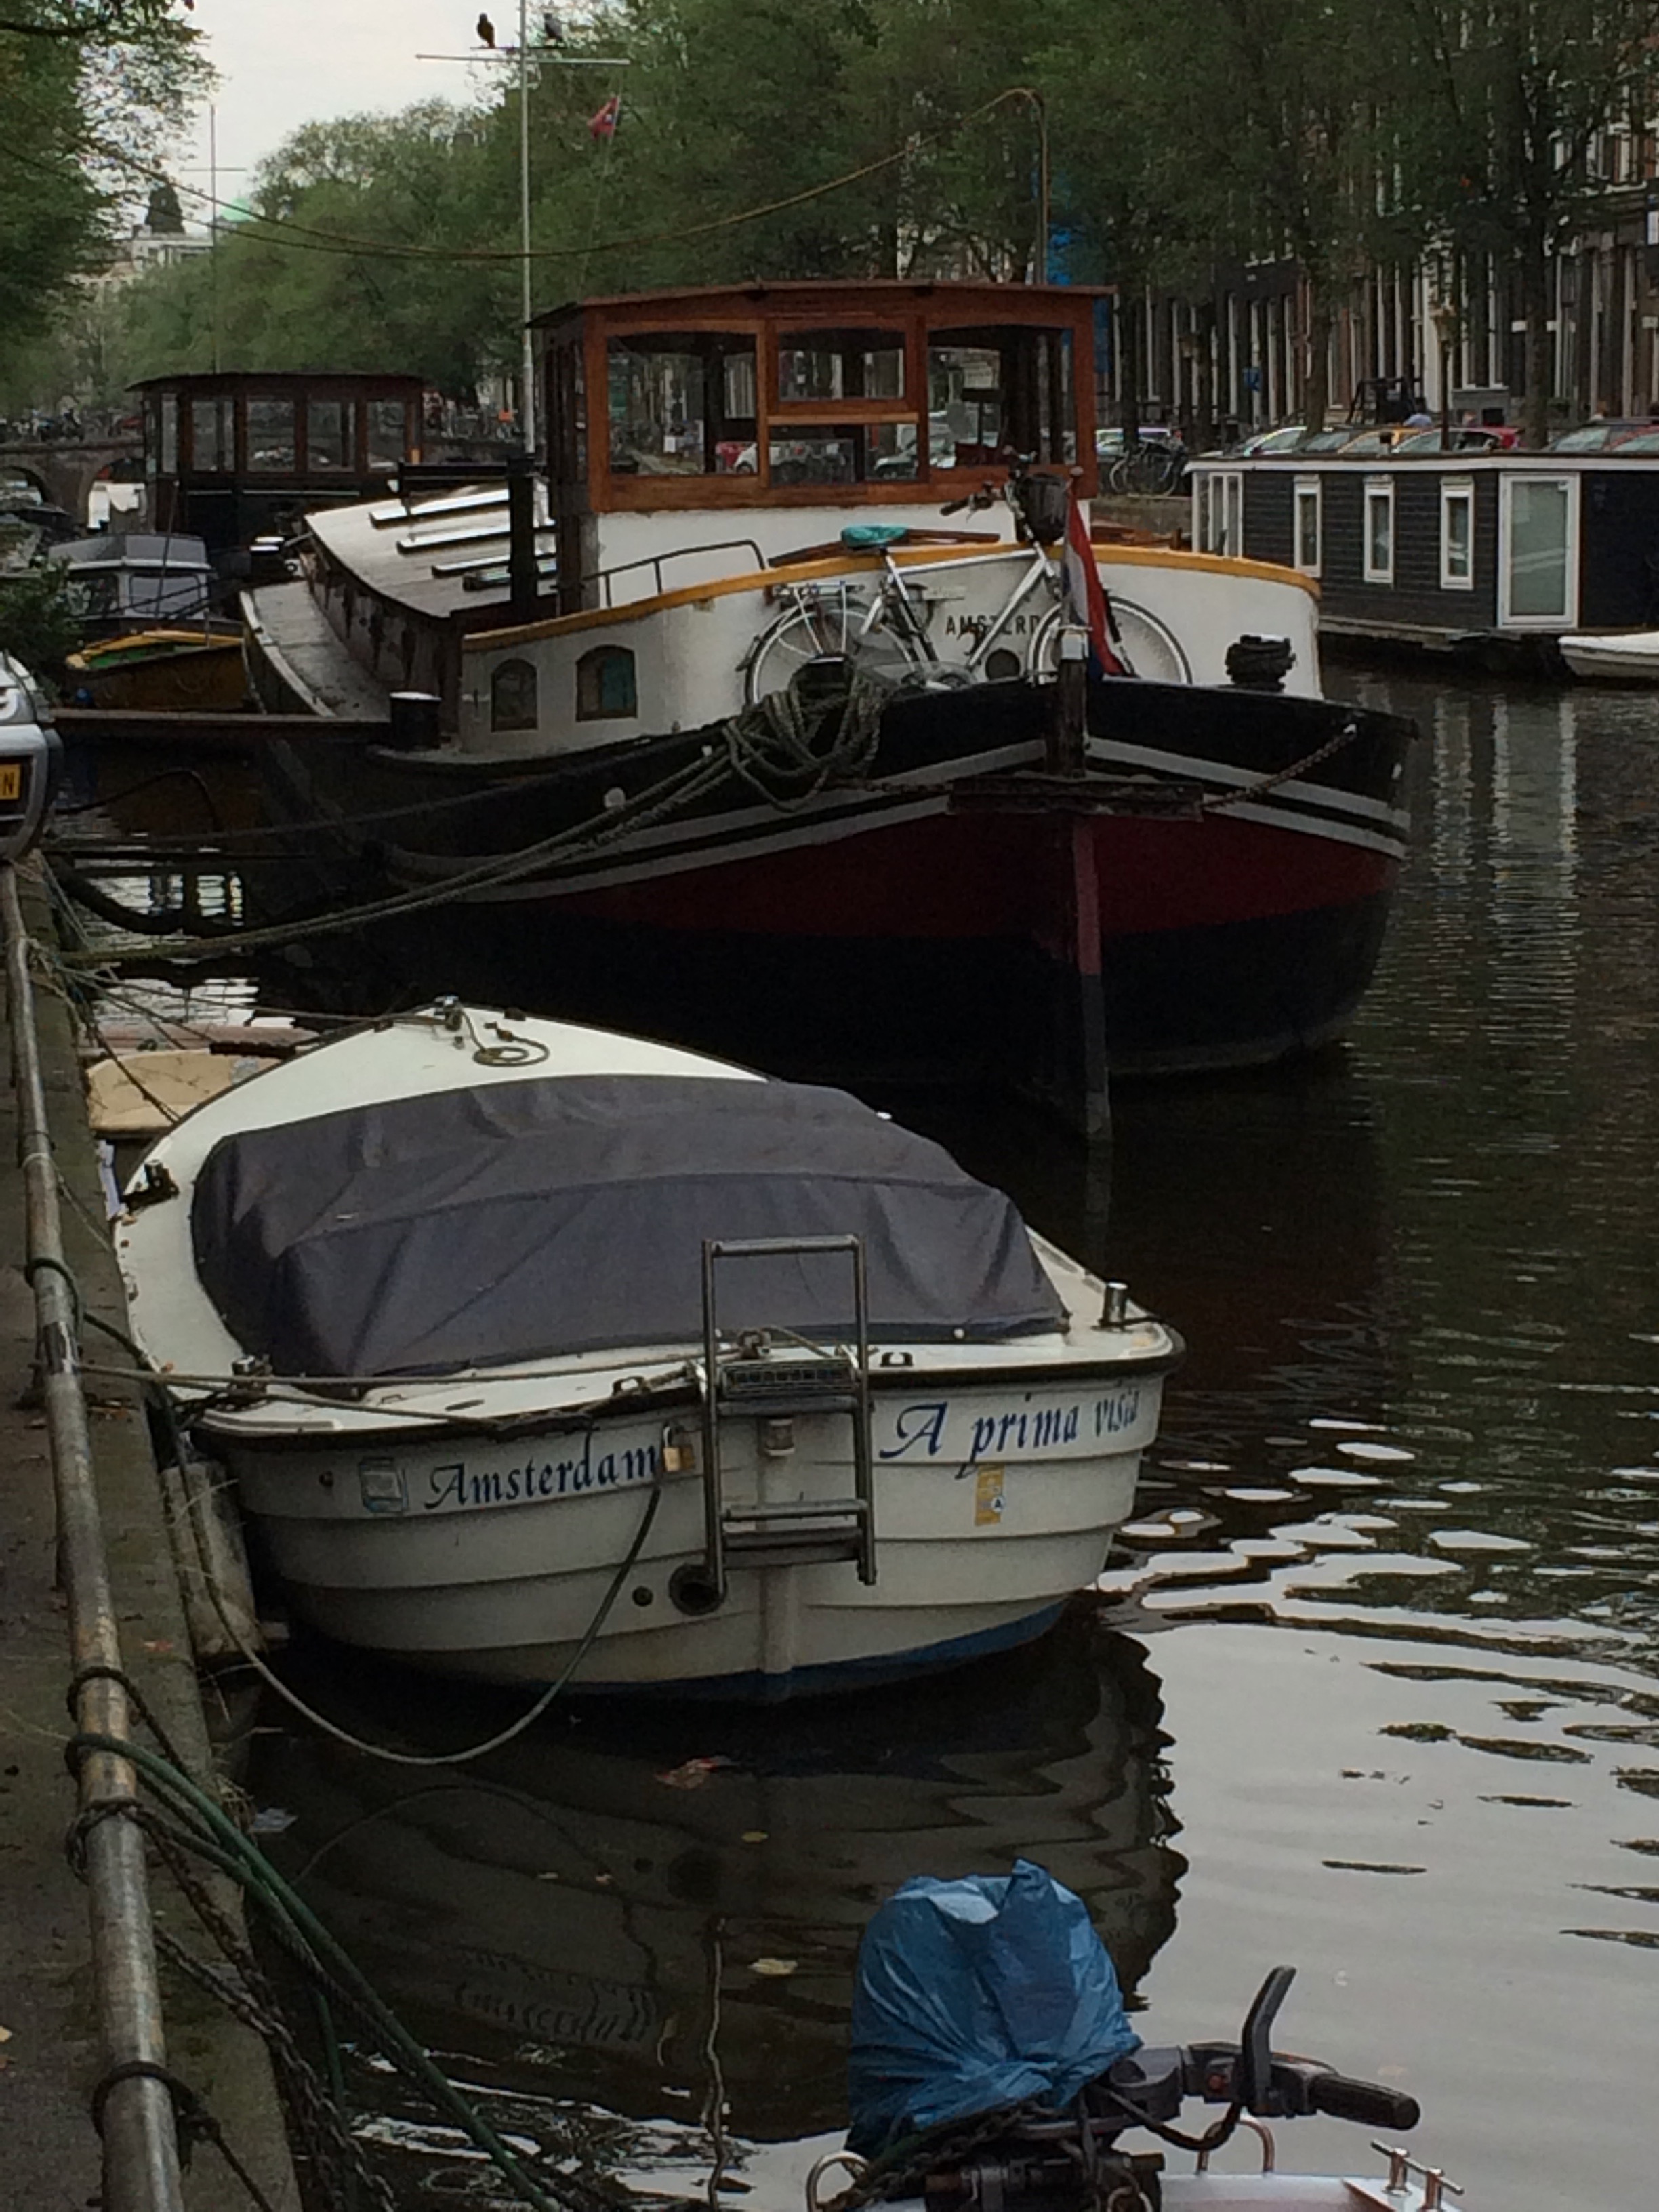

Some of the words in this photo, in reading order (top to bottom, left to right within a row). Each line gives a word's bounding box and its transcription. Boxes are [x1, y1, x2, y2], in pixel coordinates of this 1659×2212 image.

[423, 1425, 657, 1511] Amsterdam
[878, 1401, 948, 1459] A
[954, 1392, 1080, 1480] prima
